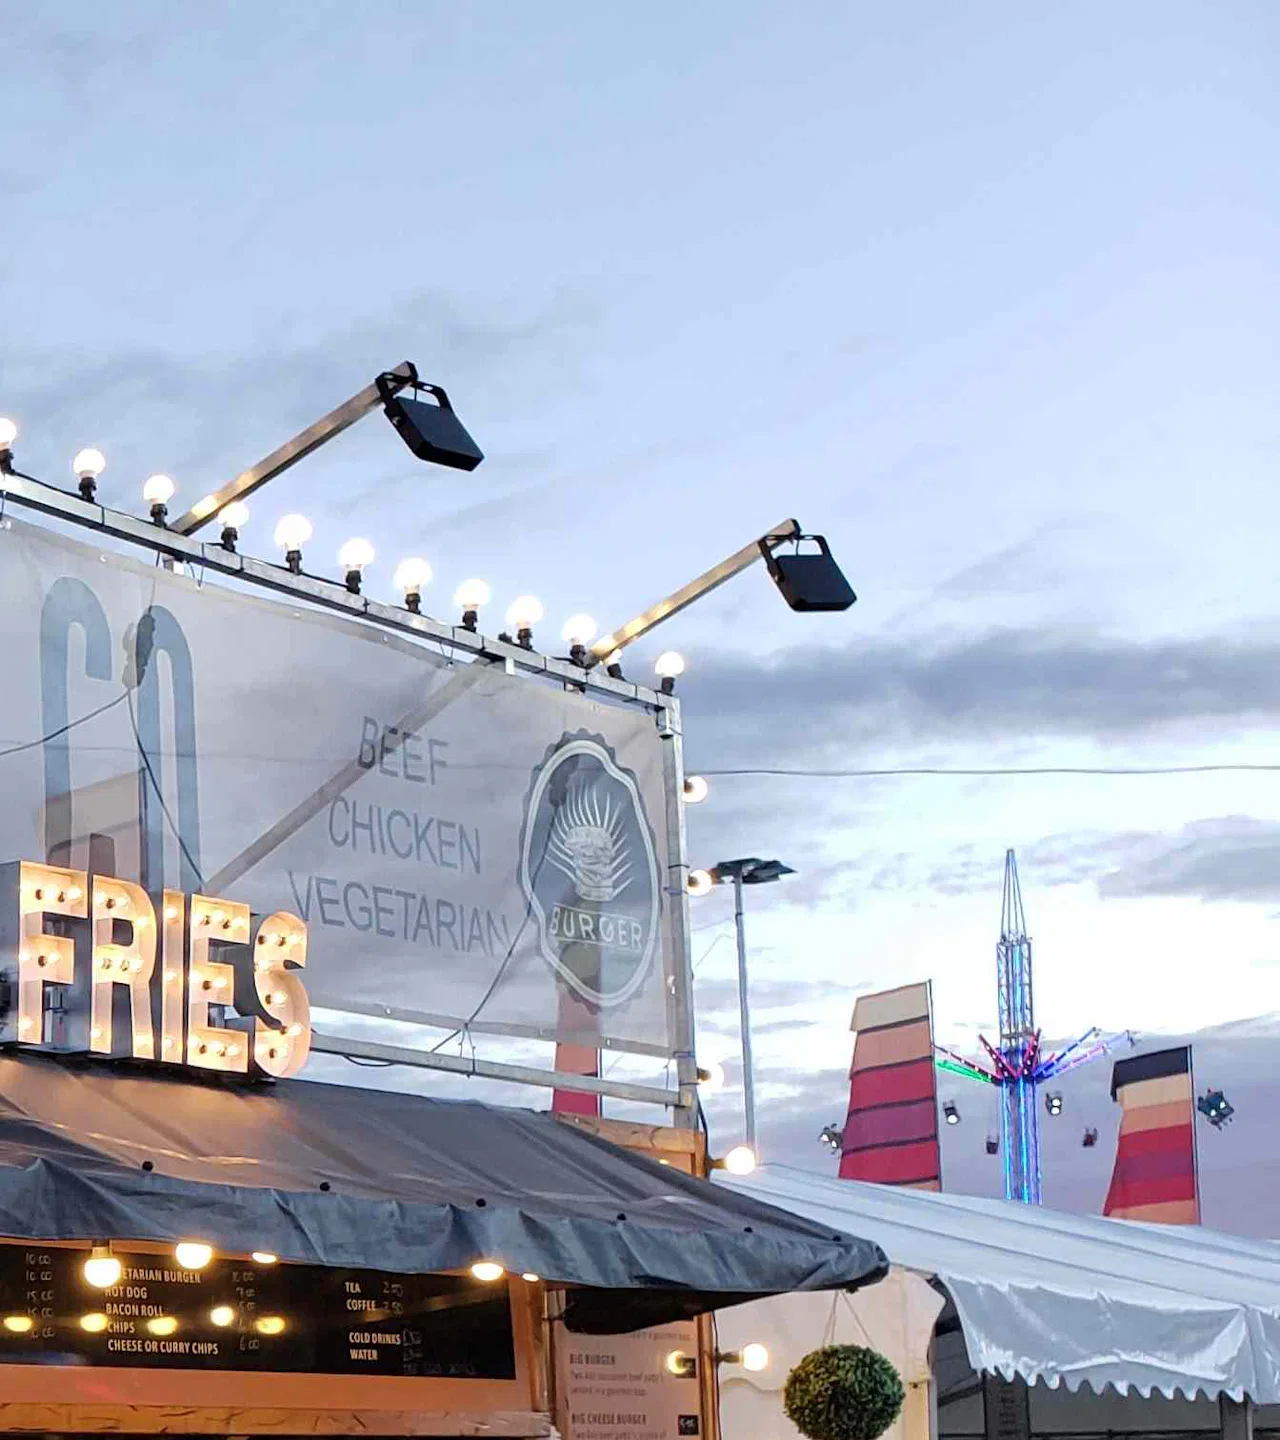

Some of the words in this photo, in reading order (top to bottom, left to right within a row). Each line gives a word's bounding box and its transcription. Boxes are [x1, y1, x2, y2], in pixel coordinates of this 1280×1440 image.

[40, 576, 200, 890] CO
[358, 715, 449, 785] BEEF
[328, 796, 481, 874] CHICKEN
[288, 870, 513, 956] VEGETARIAN
[550, 905, 643, 949] BURGER
[17, 860, 312, 1079] FRIES
[345, 1281, 361, 1294] TEA
[105, 1302, 139, 1316] BACON
[141, 1303, 164, 1317] ROLL
[346, 1298, 377, 1312] COFFEE
[107, 1320, 136, 1334] CHIPS
[107, 1338, 143, 1353] CHEESE
[144, 1339, 158, 1352] OR
[160, 1340, 190, 1355] CURRY
[192, 1341, 219, 1356] CHIPS
[349, 1331, 371, 1345] COLD
[372, 1332, 401, 1346] DRINKS
[350, 1348, 378, 1362] WATER
